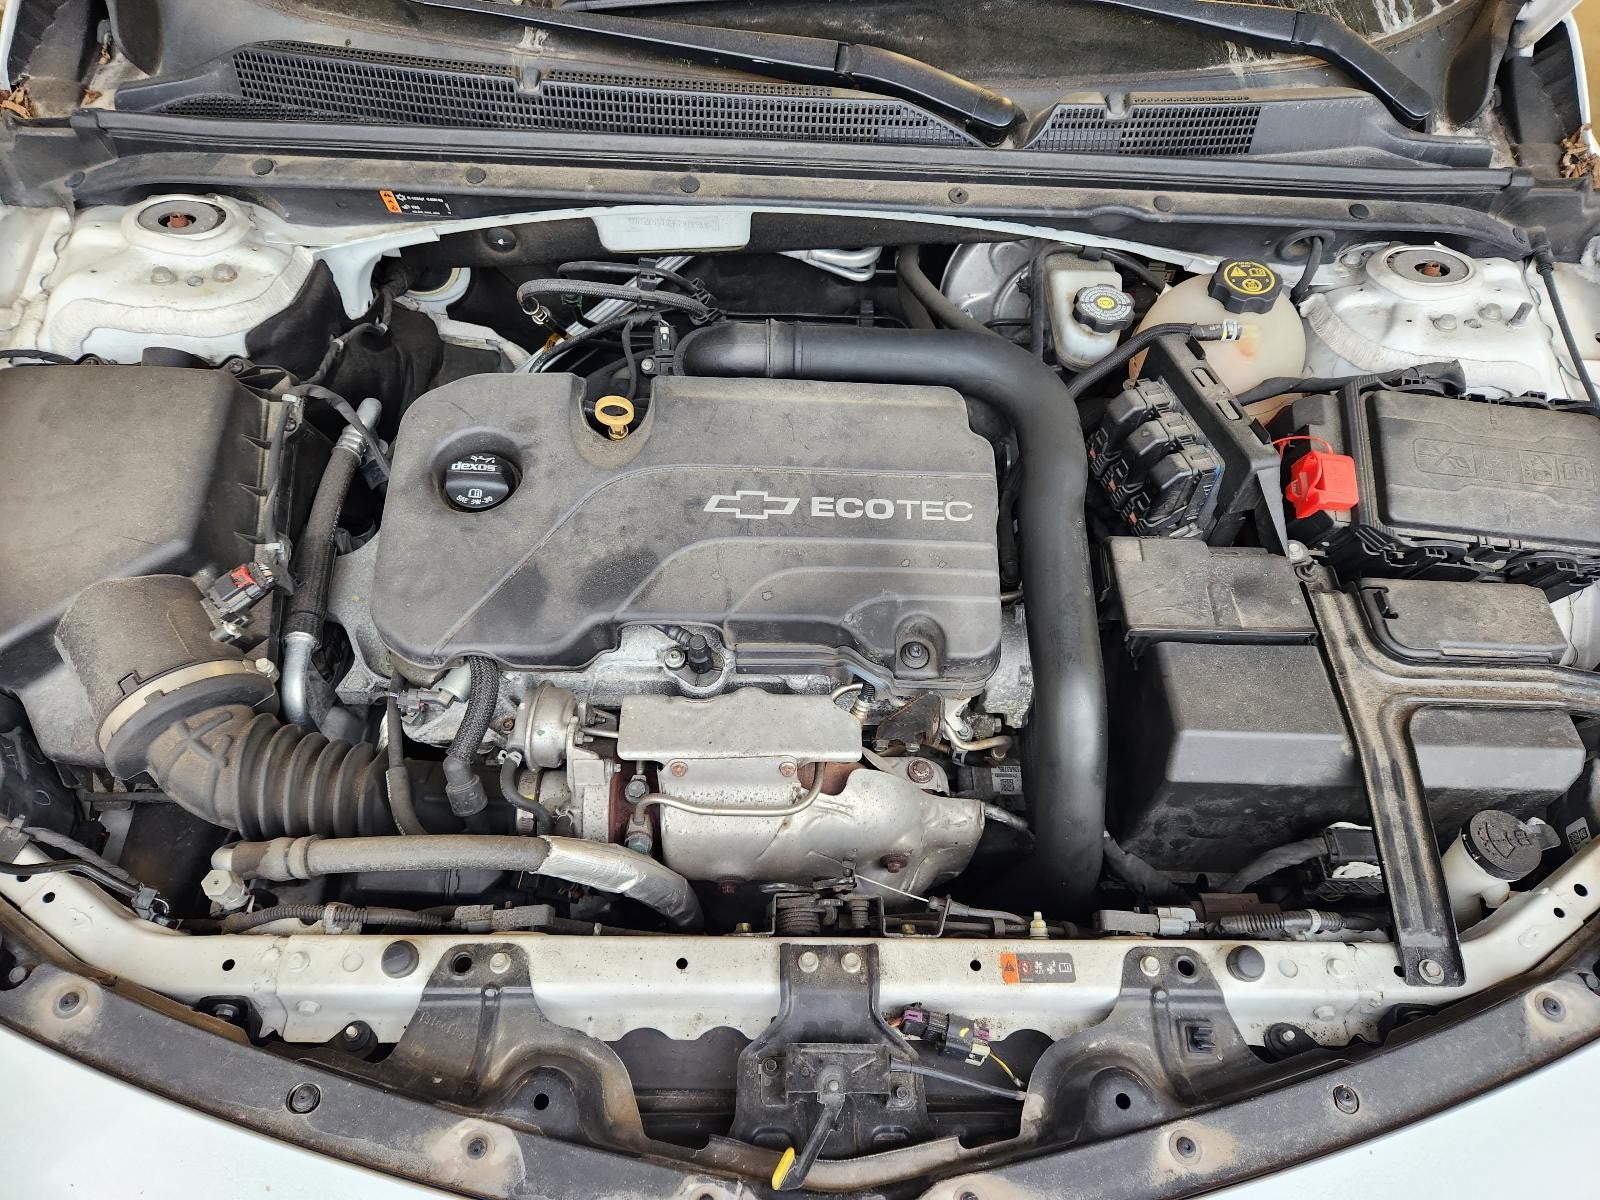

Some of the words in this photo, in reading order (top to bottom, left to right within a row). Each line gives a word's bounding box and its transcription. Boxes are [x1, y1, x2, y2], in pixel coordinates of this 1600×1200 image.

[451, 461, 496, 472] dexos
[456, 494, 469, 504] SAE
[810, 496, 974, 522] ECOTEC
